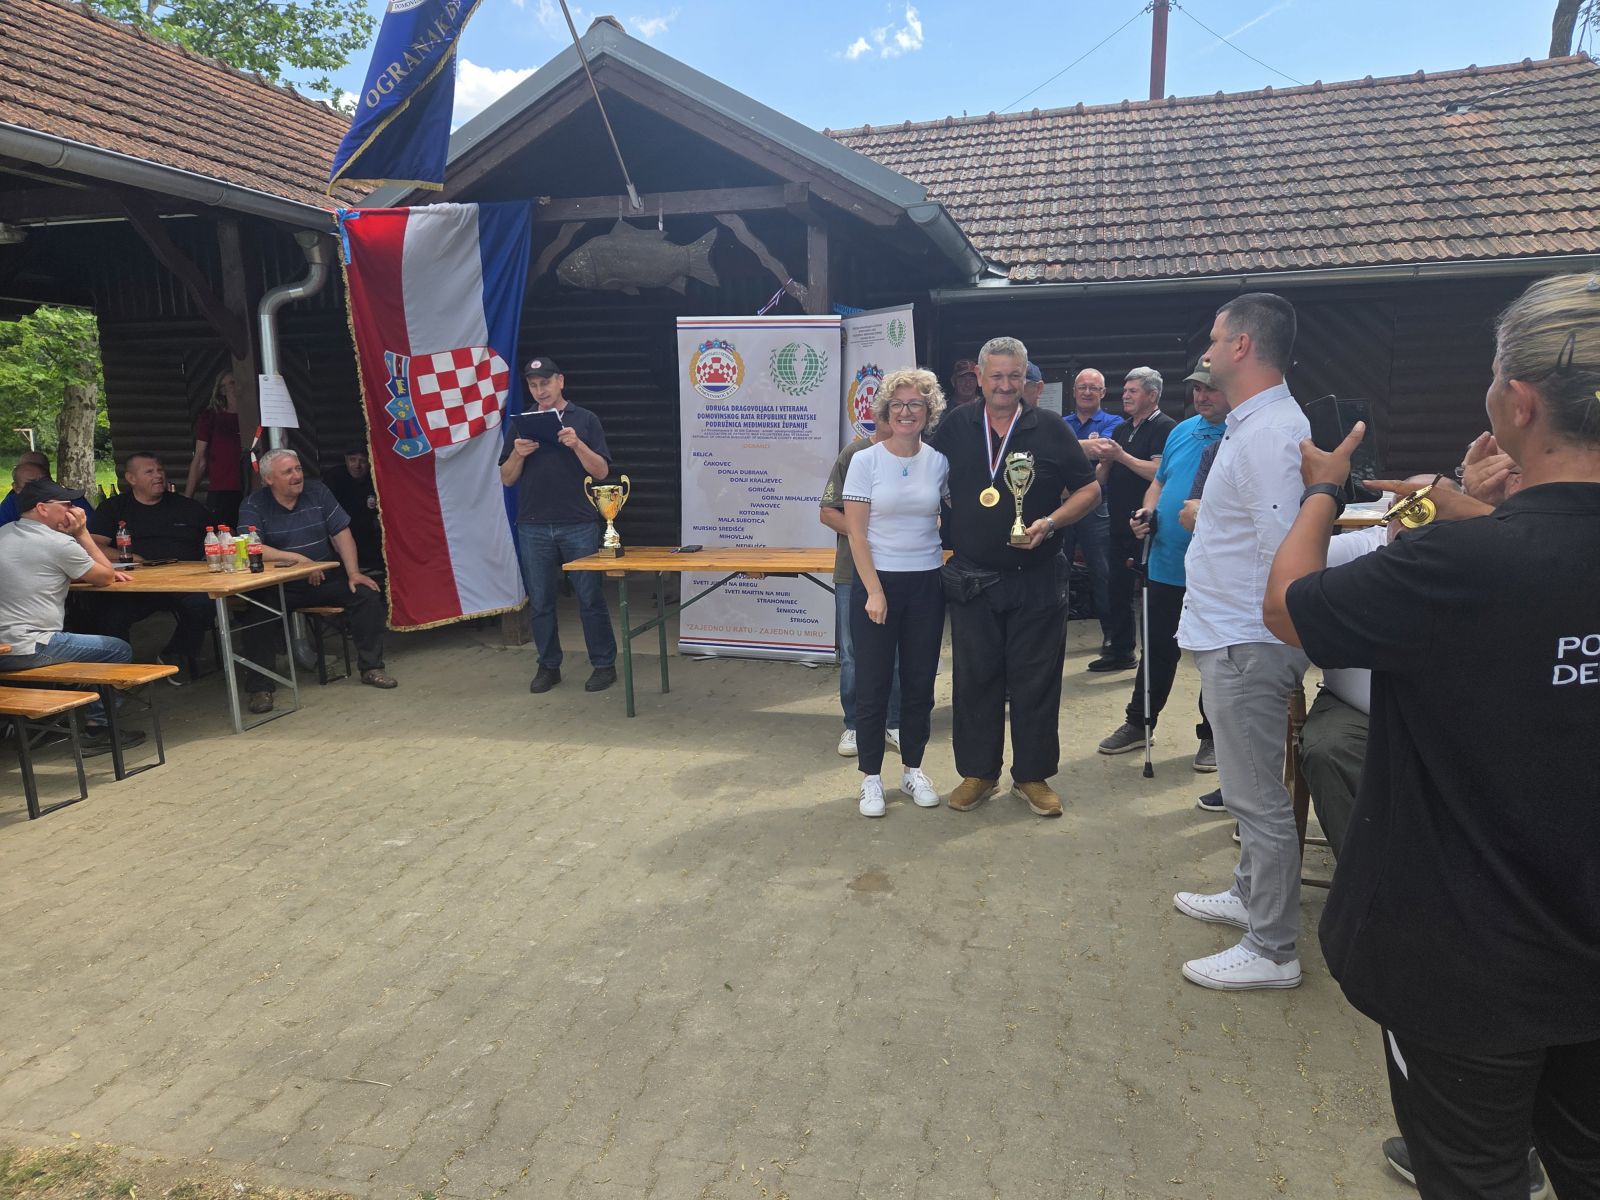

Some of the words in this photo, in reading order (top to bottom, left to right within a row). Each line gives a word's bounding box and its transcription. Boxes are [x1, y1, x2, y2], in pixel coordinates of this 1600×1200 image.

[366, 14, 450, 108] OGRANAK
[782, 421, 808, 430] ŽUPANIJE
[760, 627, 795, 636] ZAJEDNO
[1557, 634, 1600, 659] PO
